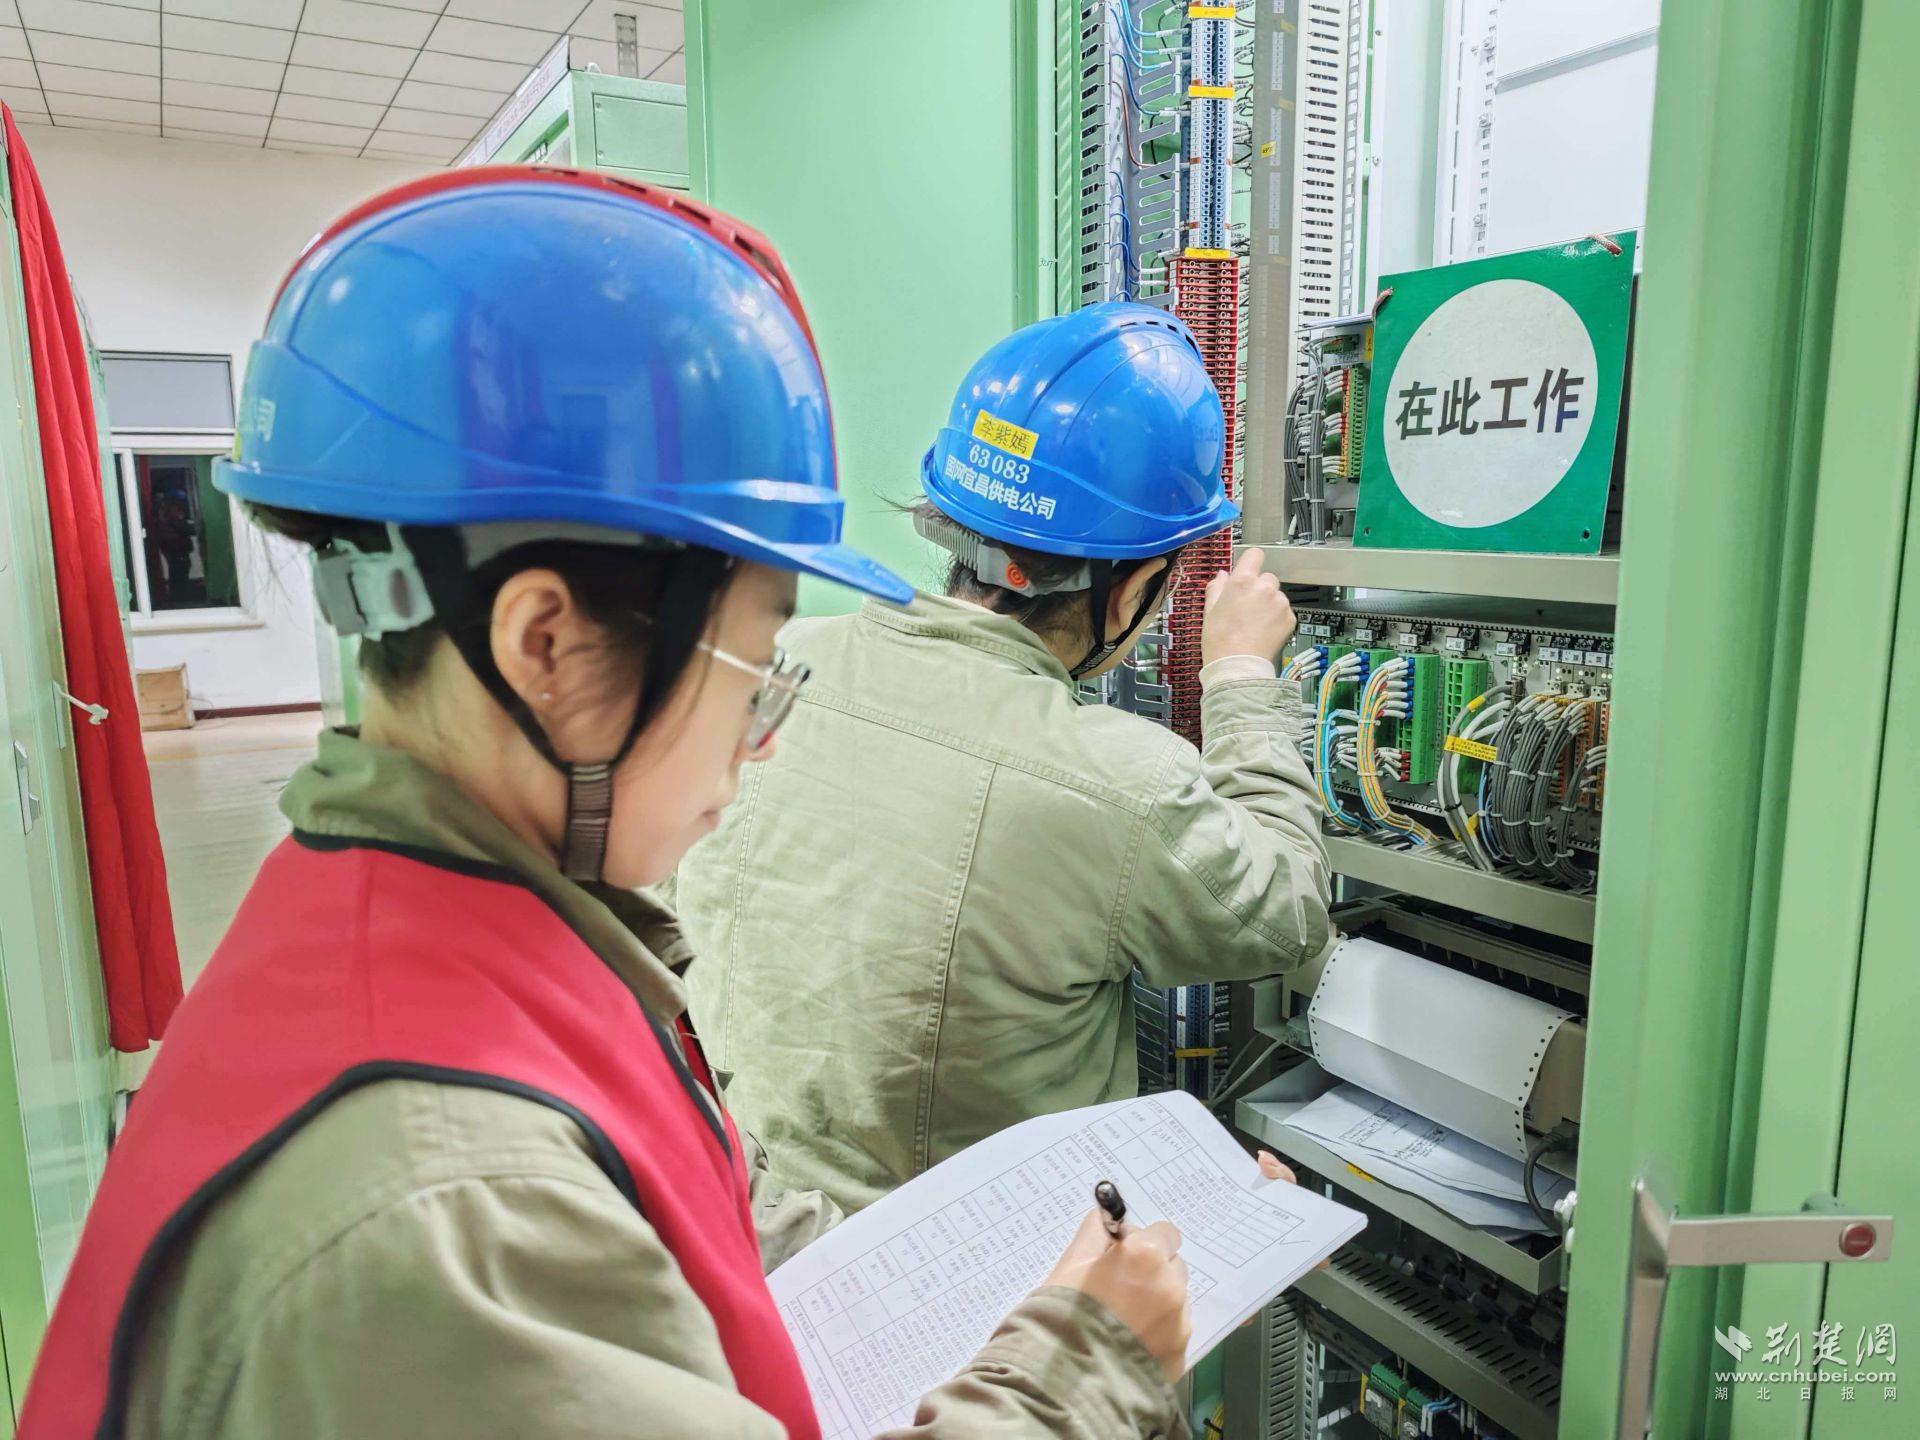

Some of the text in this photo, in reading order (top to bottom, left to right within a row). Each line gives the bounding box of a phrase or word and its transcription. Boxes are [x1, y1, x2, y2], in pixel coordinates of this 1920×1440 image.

[1395, 367, 1585, 441] 在此工作
[945, 455, 1057, 520] 国网宜昌供电公司
